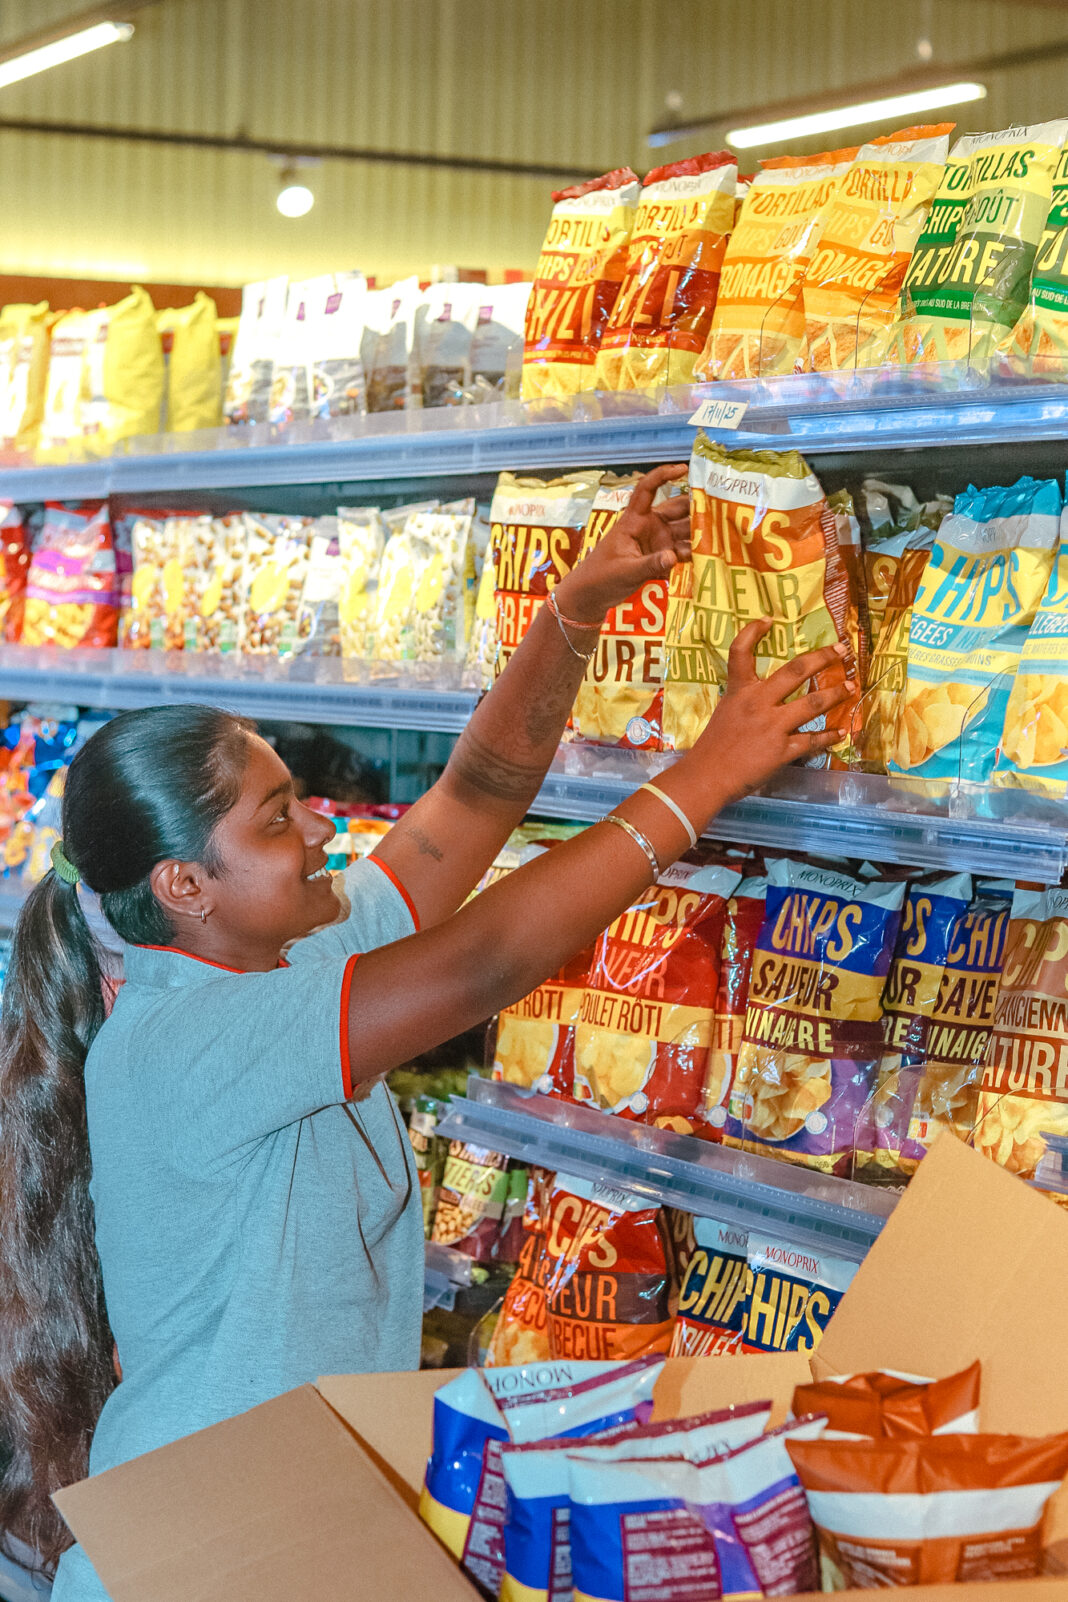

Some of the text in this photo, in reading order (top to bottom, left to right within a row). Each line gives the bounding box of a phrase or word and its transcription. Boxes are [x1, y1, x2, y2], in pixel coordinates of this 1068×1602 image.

[749, 181, 836, 217] TORTILLAS
[490, 523, 574, 592] CHIPS
[797, 869, 862, 897] MONOPRIX
[771, 894, 863, 961] CHIPS
[753, 959, 839, 1012] SAVEUR
[617, 998, 663, 1037] RÔTI
[765, 1245, 820, 1275] MONOPRIX
